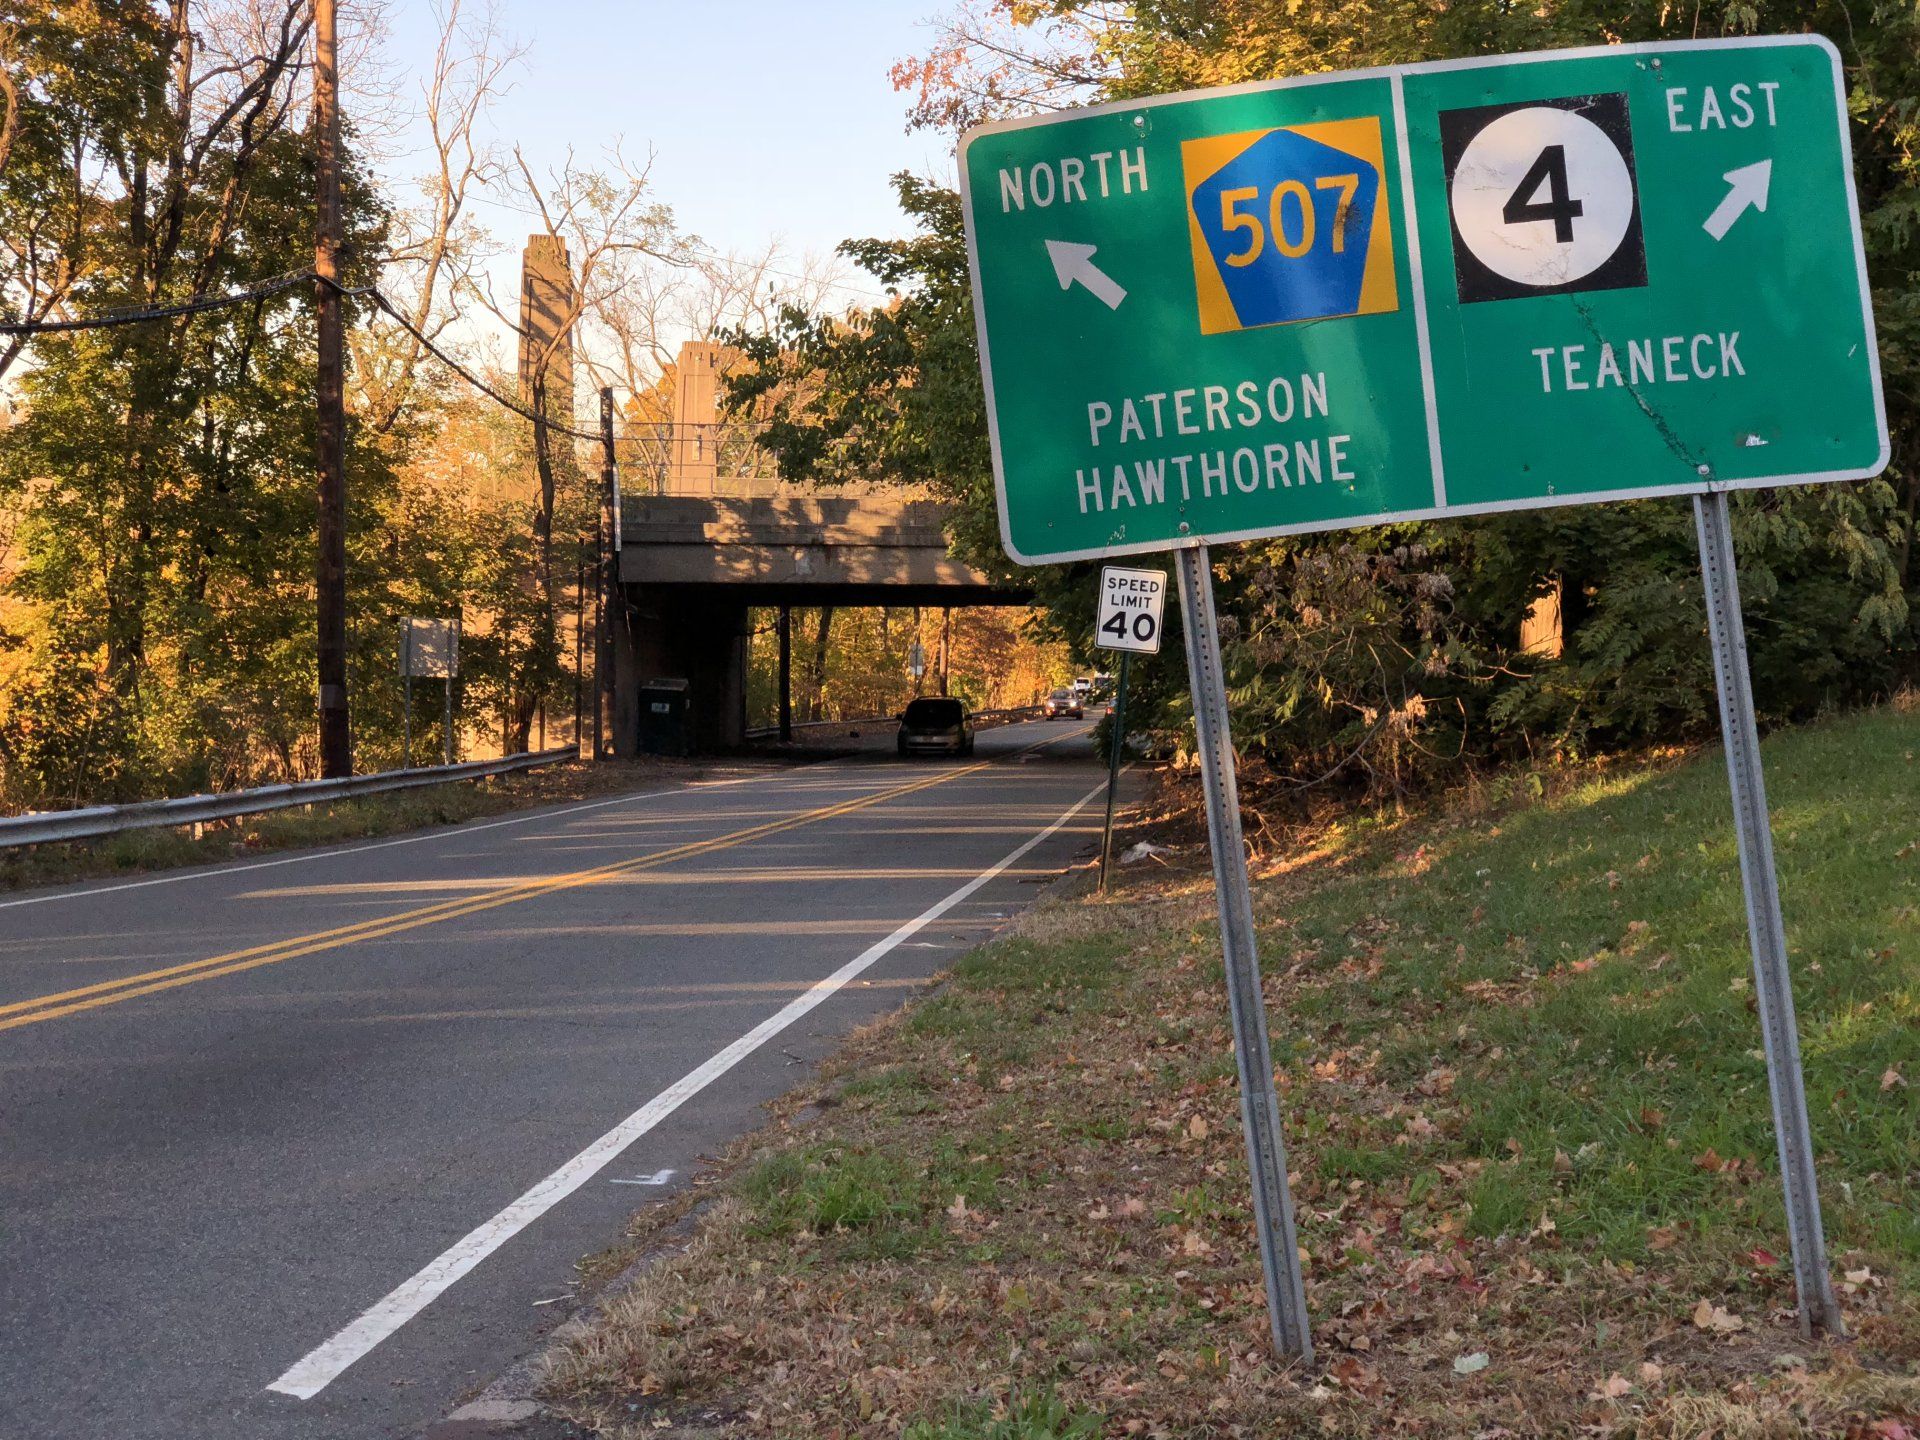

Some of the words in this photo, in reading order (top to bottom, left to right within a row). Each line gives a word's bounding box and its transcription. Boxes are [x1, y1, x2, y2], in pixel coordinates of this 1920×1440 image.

[1665, 82, 1780, 132] EAST
[999, 146, 1148, 213] NORTH
[1502, 144, 1583, 244] 4
[1219, 172, 1360, 268] 507
[1532, 331, 1746, 393] TEANECK
[1087, 371, 1330, 446] PATERSON
[1076, 434, 1355, 514] HAWTHORNE
[1107, 577, 1159, 593] SPEED
[1110, 594, 1152, 609] LIMIT
[1101, 611, 1156, 641] 40
